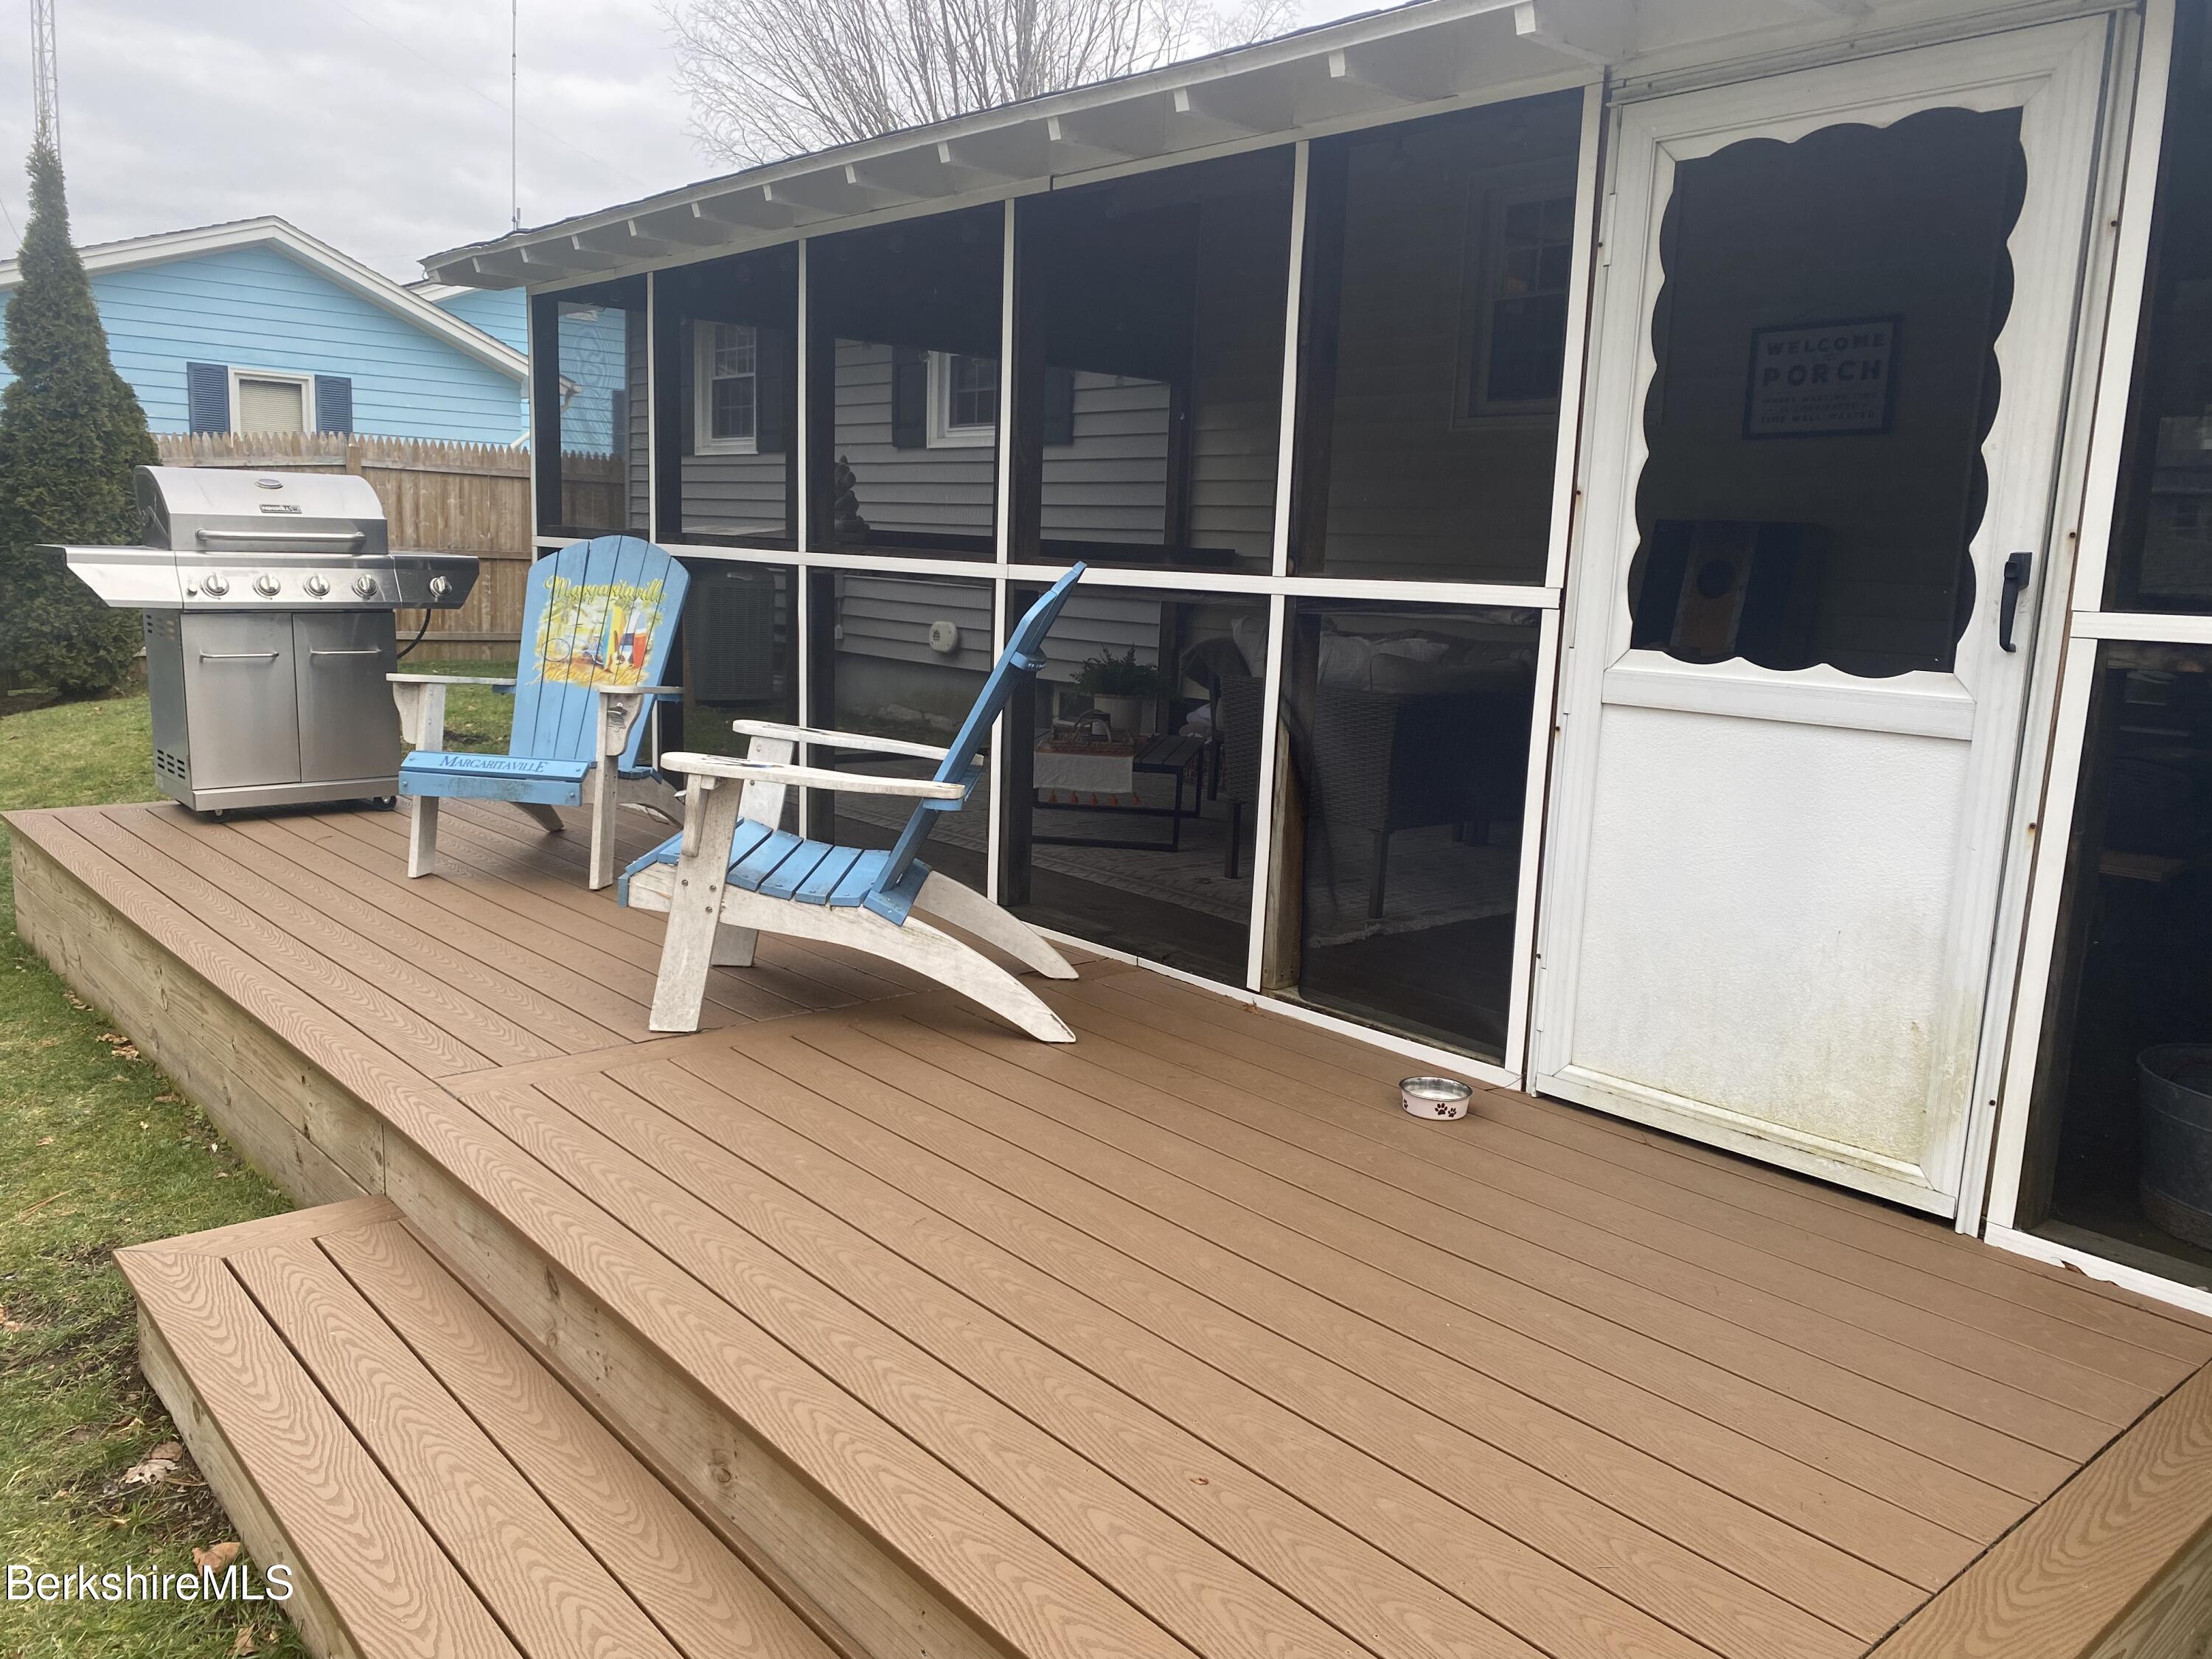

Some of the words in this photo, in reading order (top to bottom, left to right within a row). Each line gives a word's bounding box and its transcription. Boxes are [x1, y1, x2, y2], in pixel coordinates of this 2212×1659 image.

[1767, 333, 1885, 356] WELCOME
[1762, 359, 1882, 387] PORCH
[543, 574, 667, 605] Margaritaville
